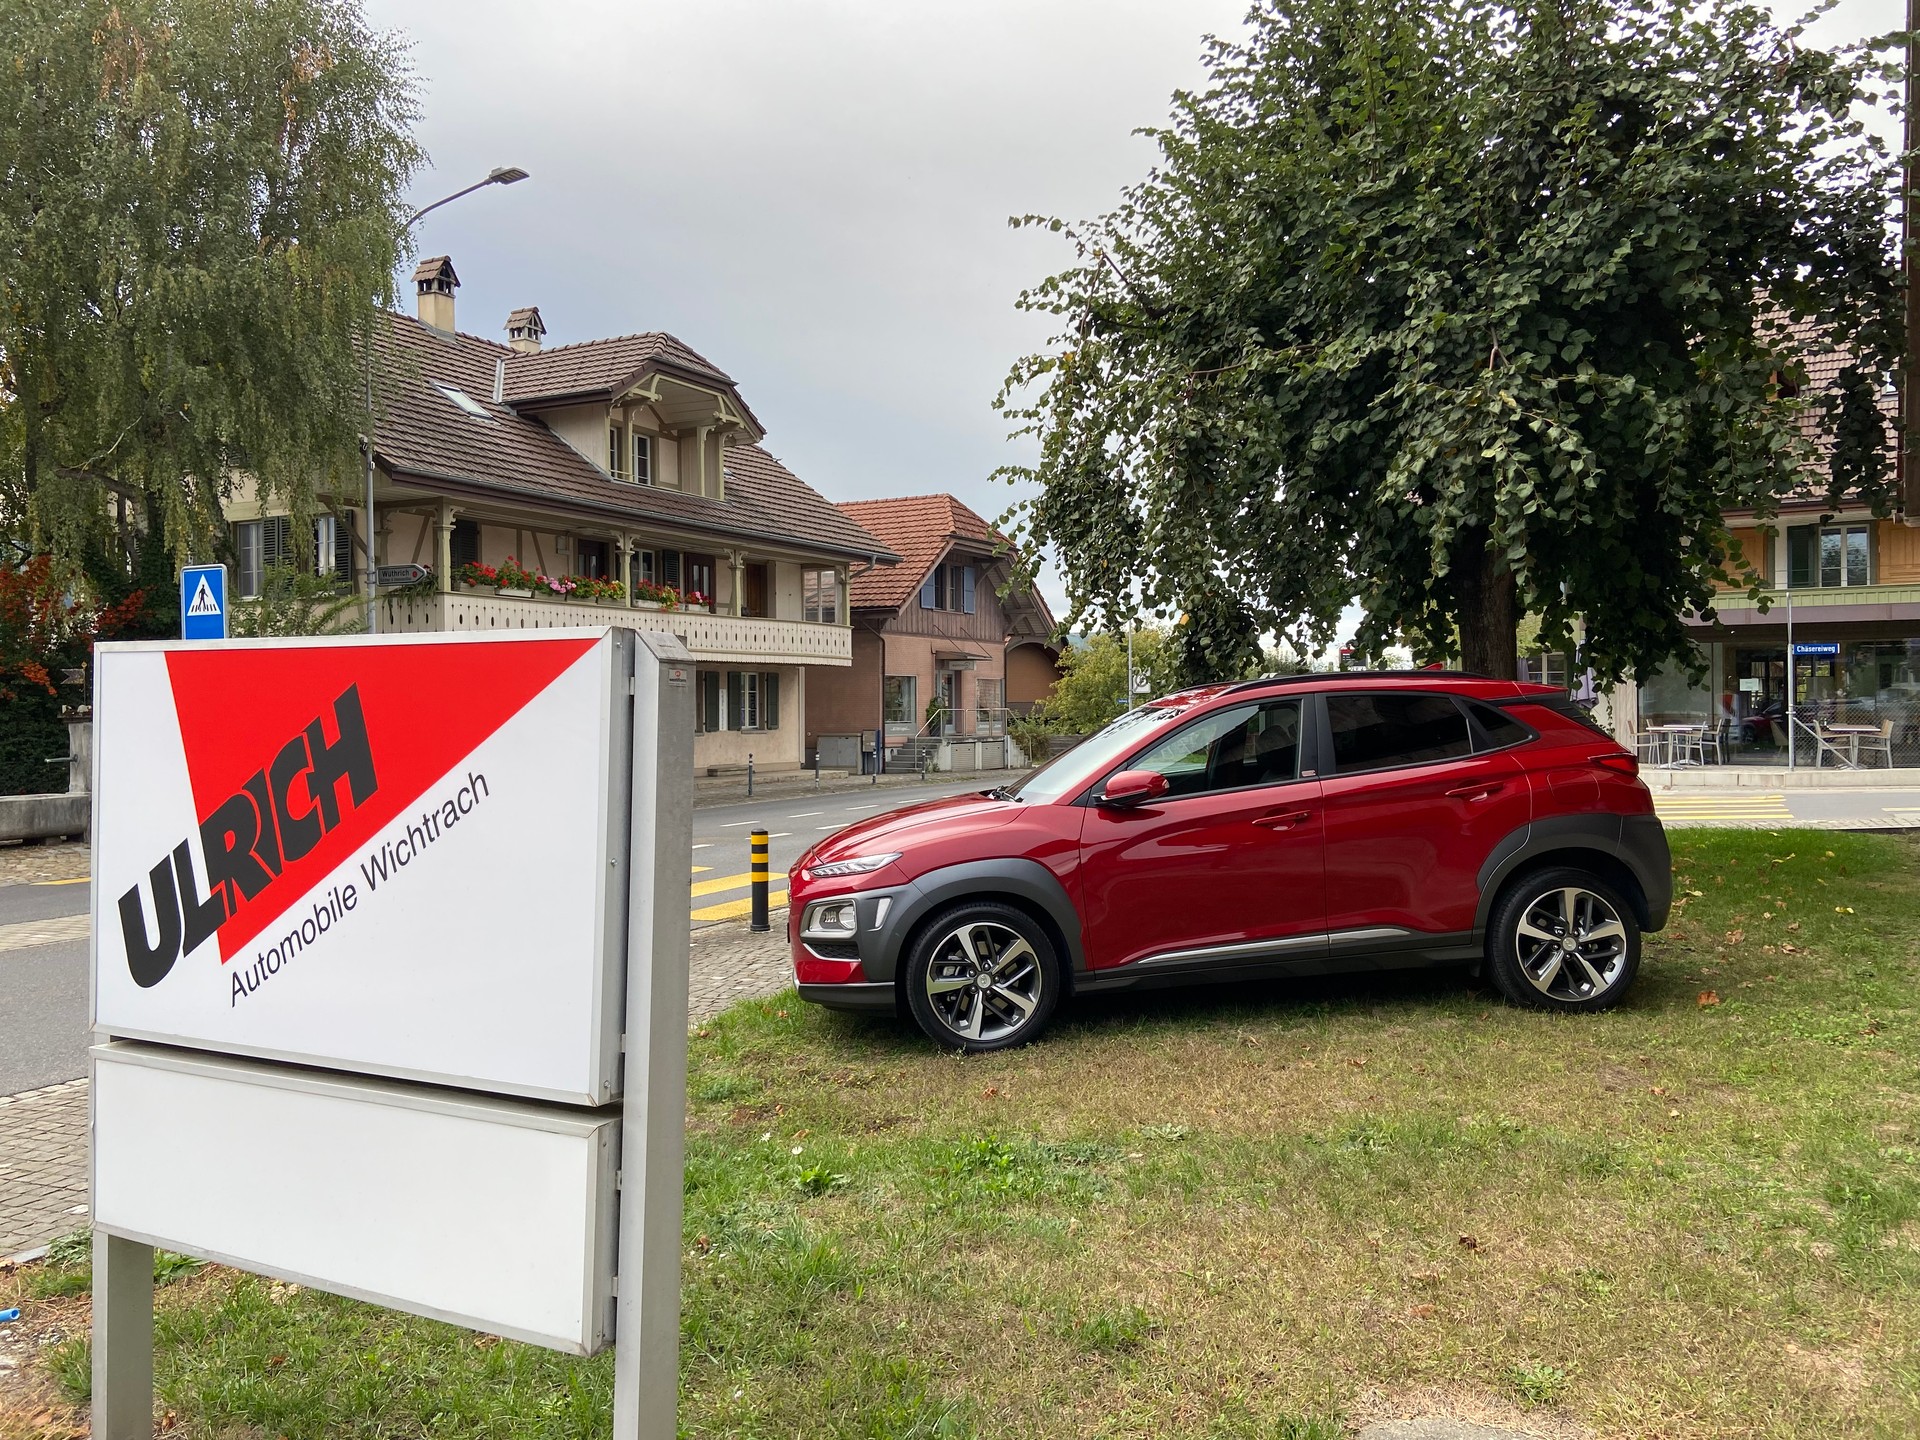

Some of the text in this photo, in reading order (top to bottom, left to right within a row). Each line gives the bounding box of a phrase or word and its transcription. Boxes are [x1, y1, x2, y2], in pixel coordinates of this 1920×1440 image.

[1796, 645, 1836, 654] Chäsereiweg
[118, 682, 379, 988] ULRICH
[231, 771, 490, 1007] Automobile Wichtrach
